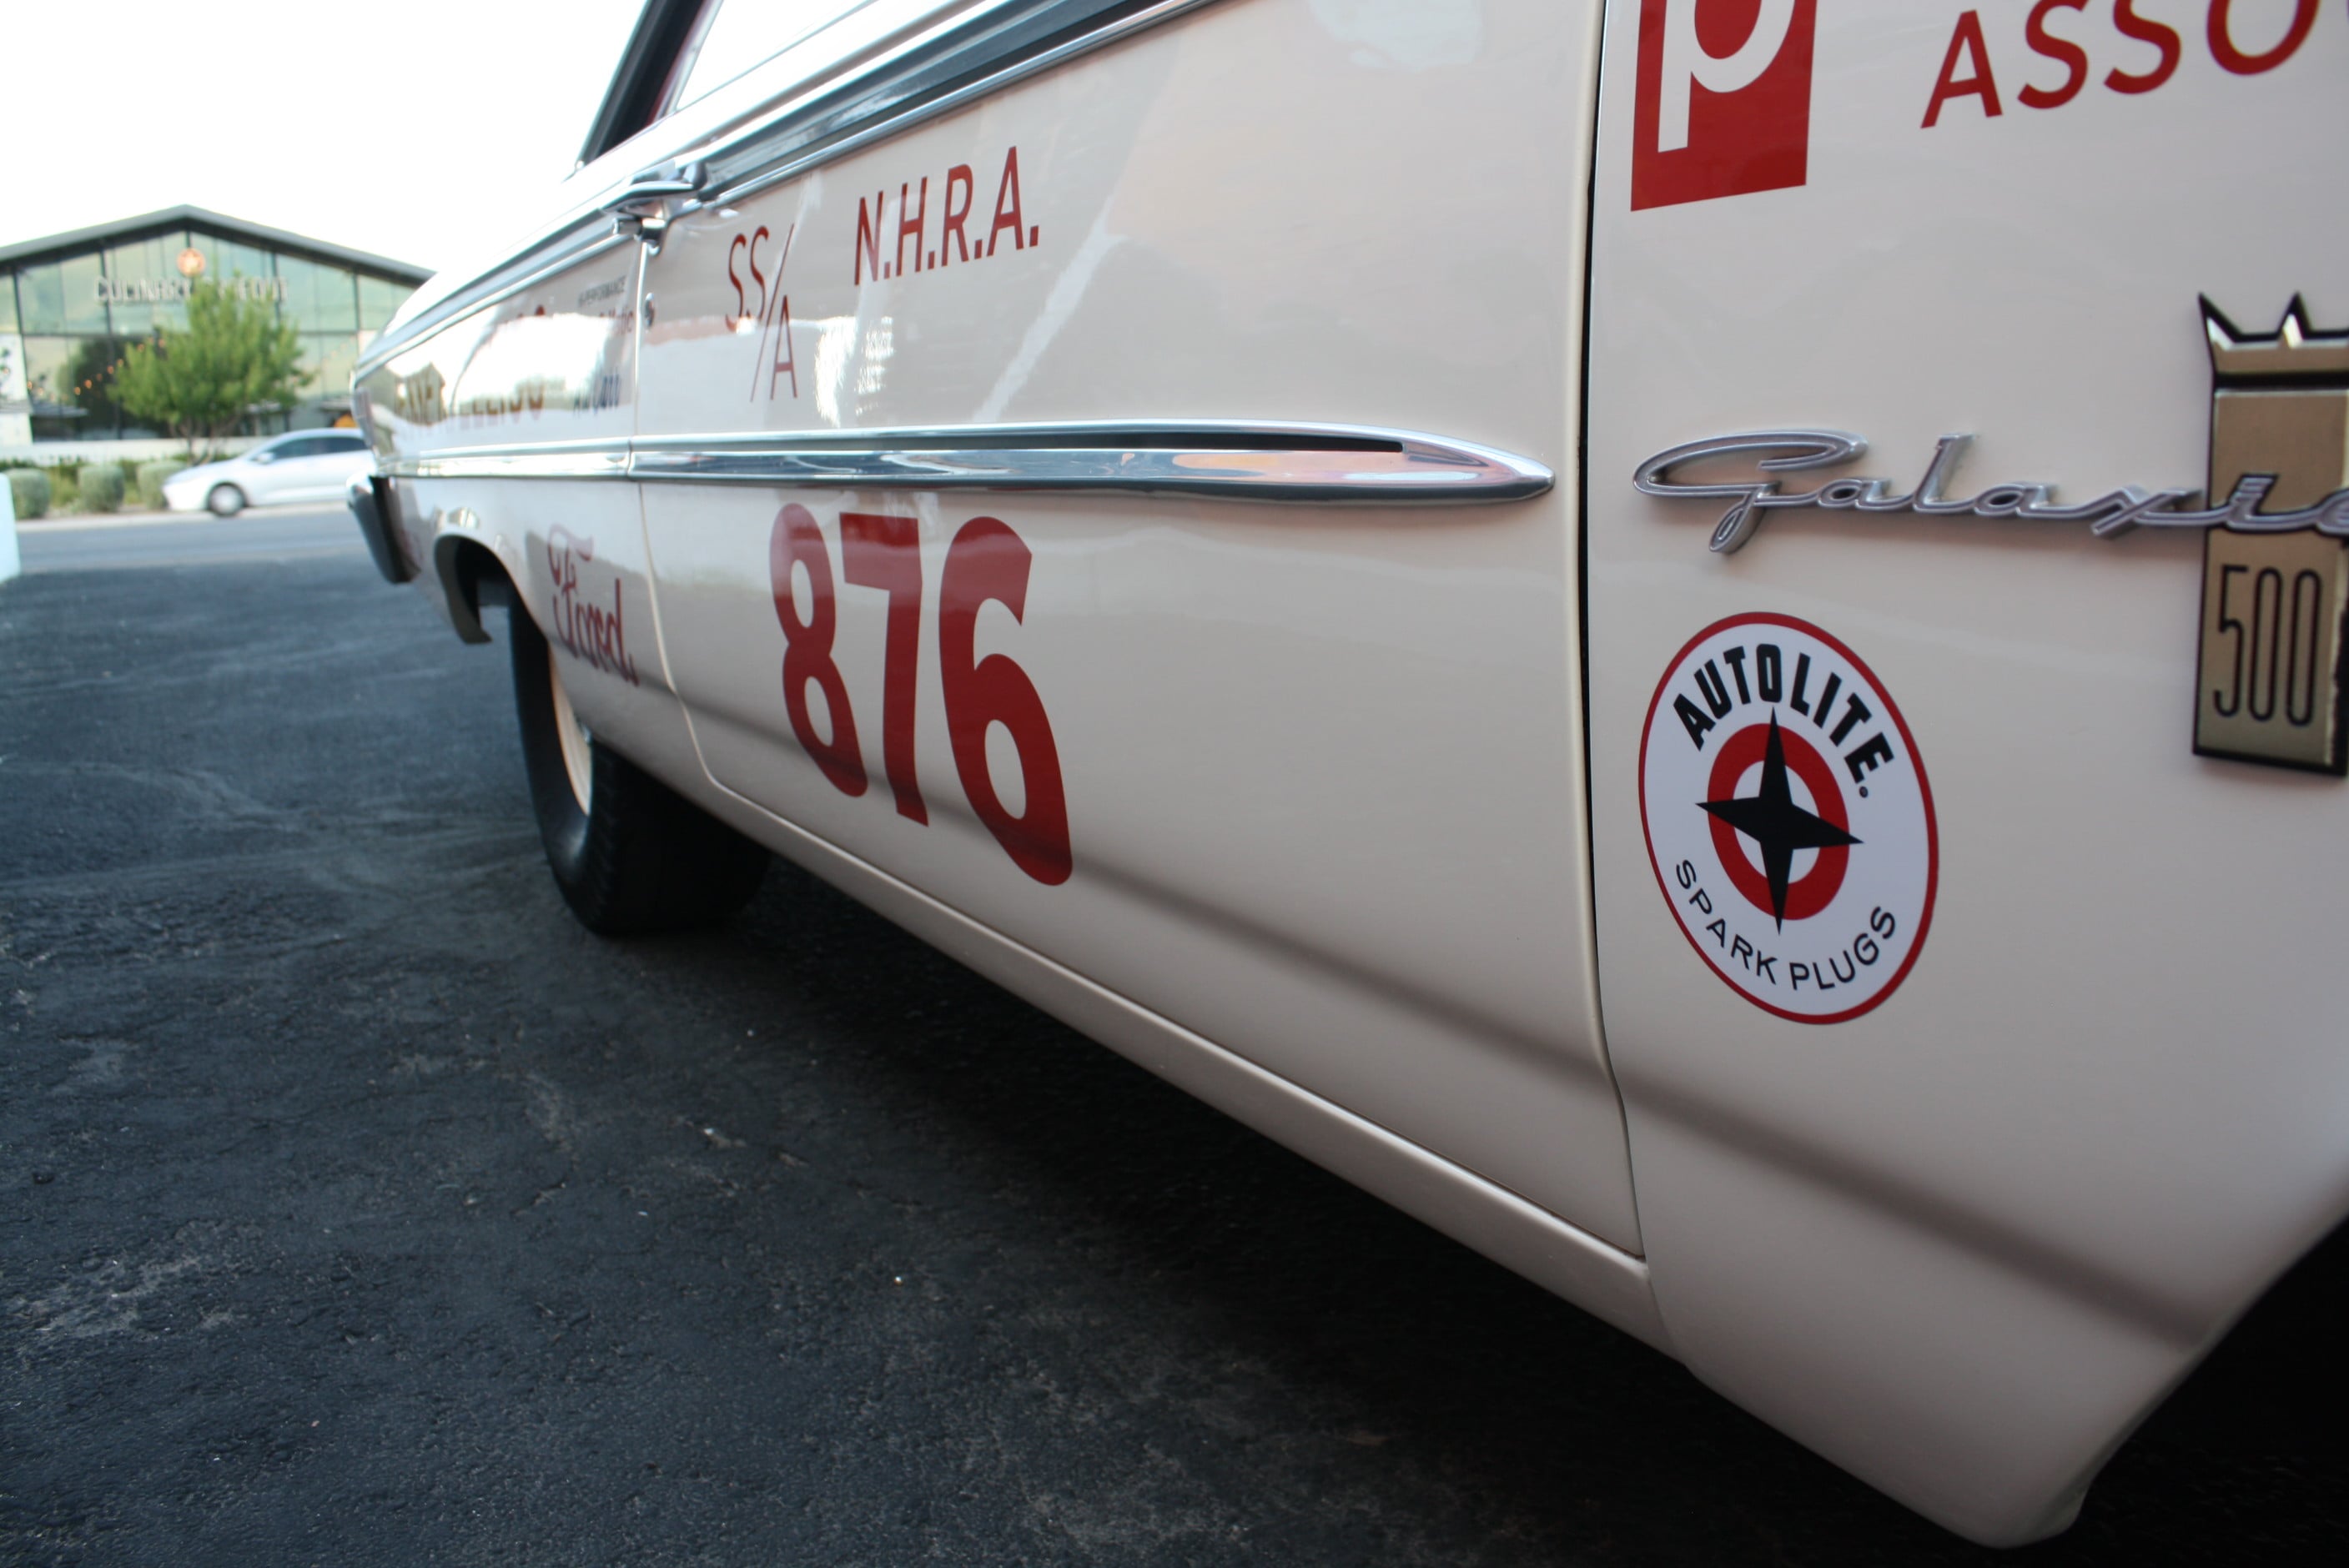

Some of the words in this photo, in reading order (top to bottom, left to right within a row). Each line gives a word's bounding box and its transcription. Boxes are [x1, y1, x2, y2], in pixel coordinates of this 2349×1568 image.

[1920, 0, 2349, 128] ASSO
[854, 146, 1039, 286] N.H.R.A.
[769, 502, 1074, 887] 876
[2211, 563, 2324, 728] 500
[1675, 858, 1778, 986] SPARK
[1788, 905, 1897, 992] PLUGS
